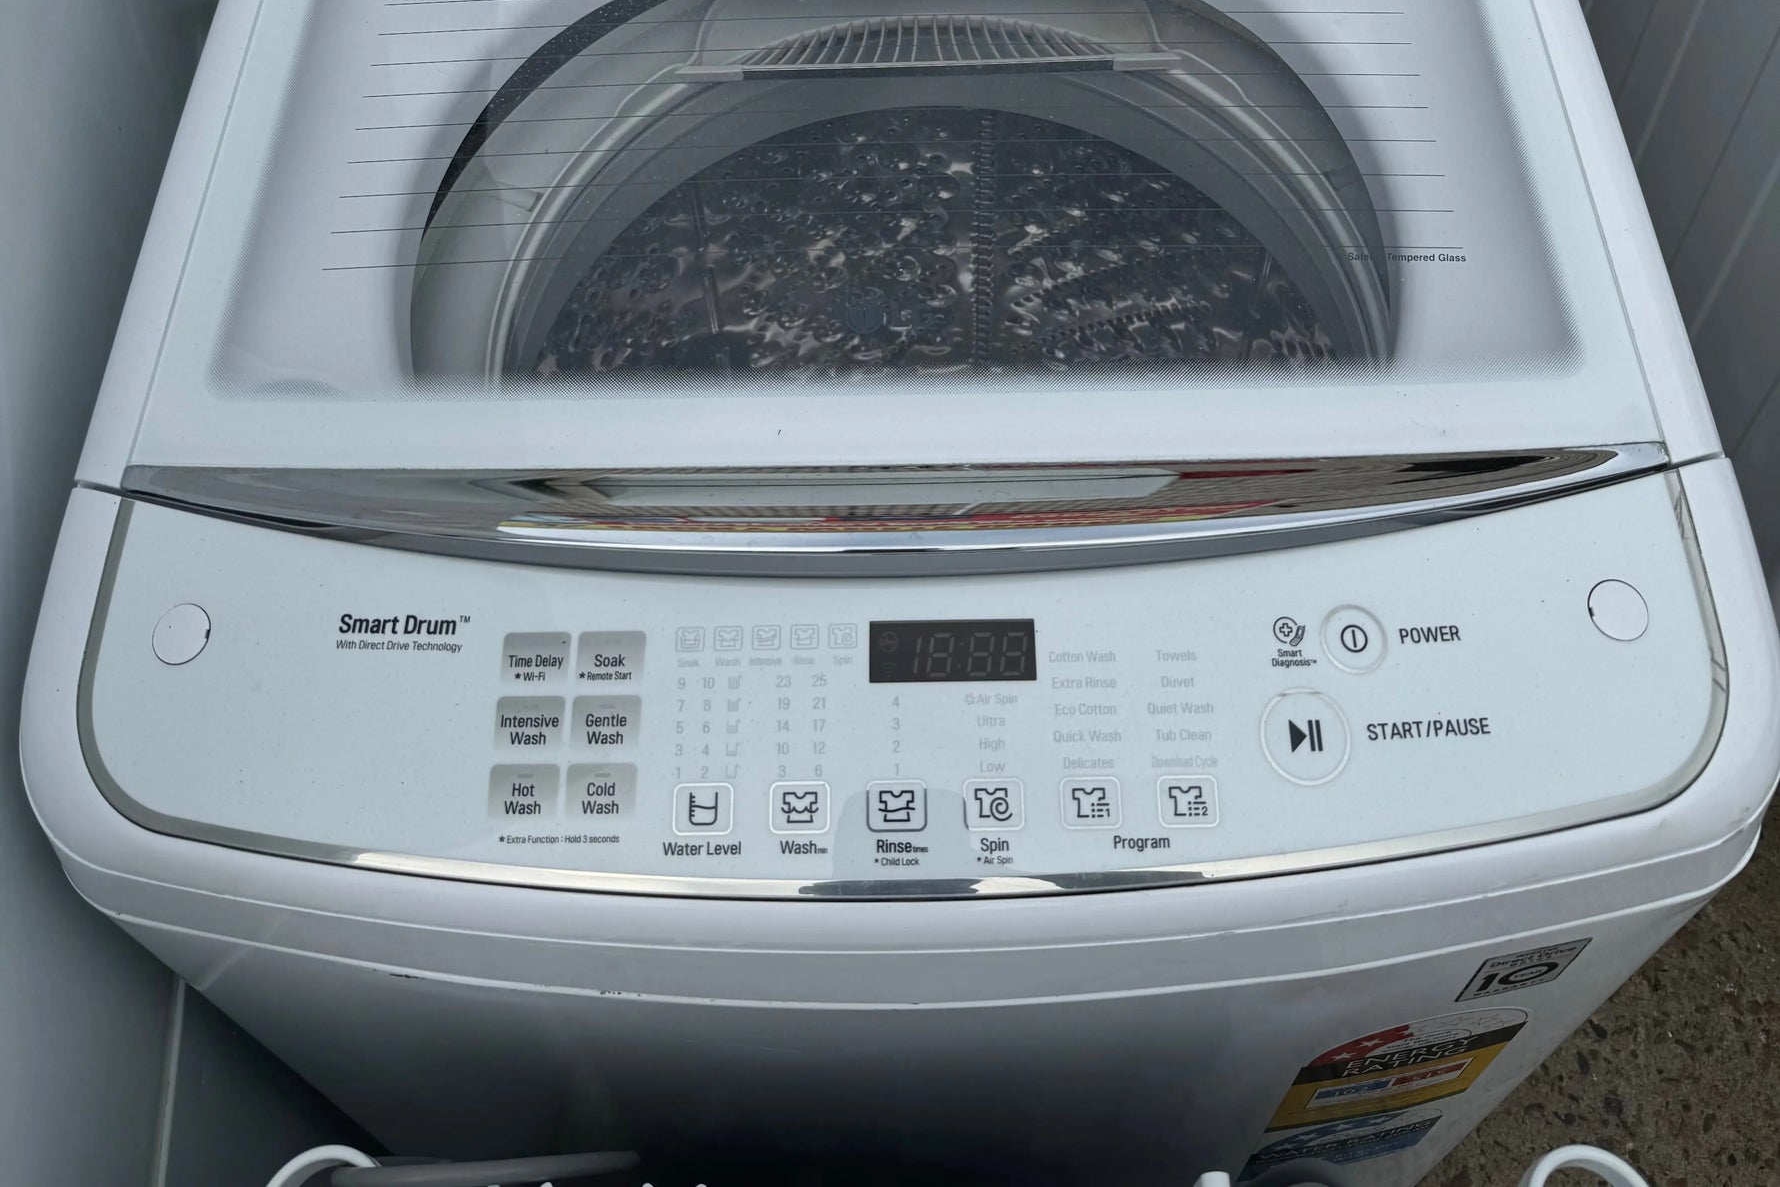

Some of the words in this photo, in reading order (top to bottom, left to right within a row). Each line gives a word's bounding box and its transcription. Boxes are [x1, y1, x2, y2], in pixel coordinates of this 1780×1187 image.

[1387, 254, 1435, 262] Tempered
[1438, 254, 1466, 262] Glass
[338, 614, 399, 635] Smart
[1399, 625, 1462, 644] POWER
[336, 640, 358, 651] With
[358, 640, 384, 652] Direct
[386, 641, 410, 652] Drive
[412, 641, 463, 654] Technology
[1277, 649, 1303, 658] Smart
[508, 655, 533, 668] Time
[534, 654, 564, 670] Delay
[594, 654, 626, 668] Soak
[1048, 650, 1084, 663] Cotton
[1086, 650, 1116, 662] Wash
[1156, 649, 1198, 662] Towels
[523, 671, 546, 682] Wi-Fi
[586, 672, 614, 681] Remote
[615, 671, 632, 681] Start
[776, 675, 792, 688] 23
[812, 674, 828, 687] 25
[1052, 677, 1083, 689] Extra
[1085, 676, 1117, 688] Rinse
[1161, 676, 1195, 688] Duvet
[678, 677, 686, 690] 9
[702, 677, 715, 689] 10
[677, 699, 685, 712] 7
[704, 699, 712, 712] 8
[778, 697, 790, 710] 19
[812, 697, 826, 710] 21
[892, 696, 900, 707] 4
[977, 694, 990, 705] Air
[994, 693, 1018, 706] Spin
[1054, 703, 1076, 715] Eco
[1078, 703, 1117, 715] Cotton
[1147, 702, 1178, 715] Quiet
[1180, 702, 1214, 714] Wash
[500, 714, 560, 728] Intensive
[585, 714, 628, 728] Gentle
[676, 721, 684, 734] 5
[702, 720, 710, 734] 6
[776, 720, 790, 732] 14
[812, 719, 826, 732] 17
[892, 718, 900, 730] 3
[977, 715, 1006, 727] Ultra
[1156, 729, 1177, 742] Tub
[1179, 729, 1212, 741] Clean
[1366, 717, 1492, 741] START/PAUSE
[510, 732, 547, 746] Wash
[586, 732, 624, 746] Wash
[1053, 730, 1085, 743] Quick
[1088, 730, 1122, 743] Wash
[675, 744, 682, 757] 3
[702, 743, 710, 756] 4
[776, 742, 790, 755] 10
[812, 742, 826, 754] 12
[892, 740, 900, 753] 2
[979, 738, 1006, 752] High
[895, 763, 900, 776] 1
[980, 760, 1006, 772] Low
[1063, 757, 1115, 770] Delicates
[676, 766, 681, 779] 1
[700, 766, 710, 779] 2
[778, 765, 786, 778] 3
[814, 764, 823, 777] 6
[512, 783, 535, 798] Hot
[586, 782, 616, 797] Cold
[504, 801, 542, 815] Wash
[582, 801, 620, 815] Wash
[1105, 808, 1110, 818] 1
[1202, 806, 1208, 816] 2
[506, 834, 526, 844] Extra
[527, 834, 560, 844] Function
[564, 834, 581, 844] Hold
[582, 835, 588, 844] 3
[588, 834, 620, 844] seconds
[980, 837, 1010, 854] Spin
[1113, 835, 1170, 853] Program
[662, 842, 703, 857] Water
[706, 840, 742, 856] Level
[780, 840, 818, 855] Wash
[876, 838, 912, 854] Rinse
[880, 858, 900, 866] Child
[902, 857, 920, 866] Lock
[984, 856, 995, 864] Air
[996, 856, 1014, 866] Spin
[1477, 962, 1559, 992] 10
[1346, 1036, 1478, 1068] ENERGY
[1342, 1046, 1468, 1076] RATING
